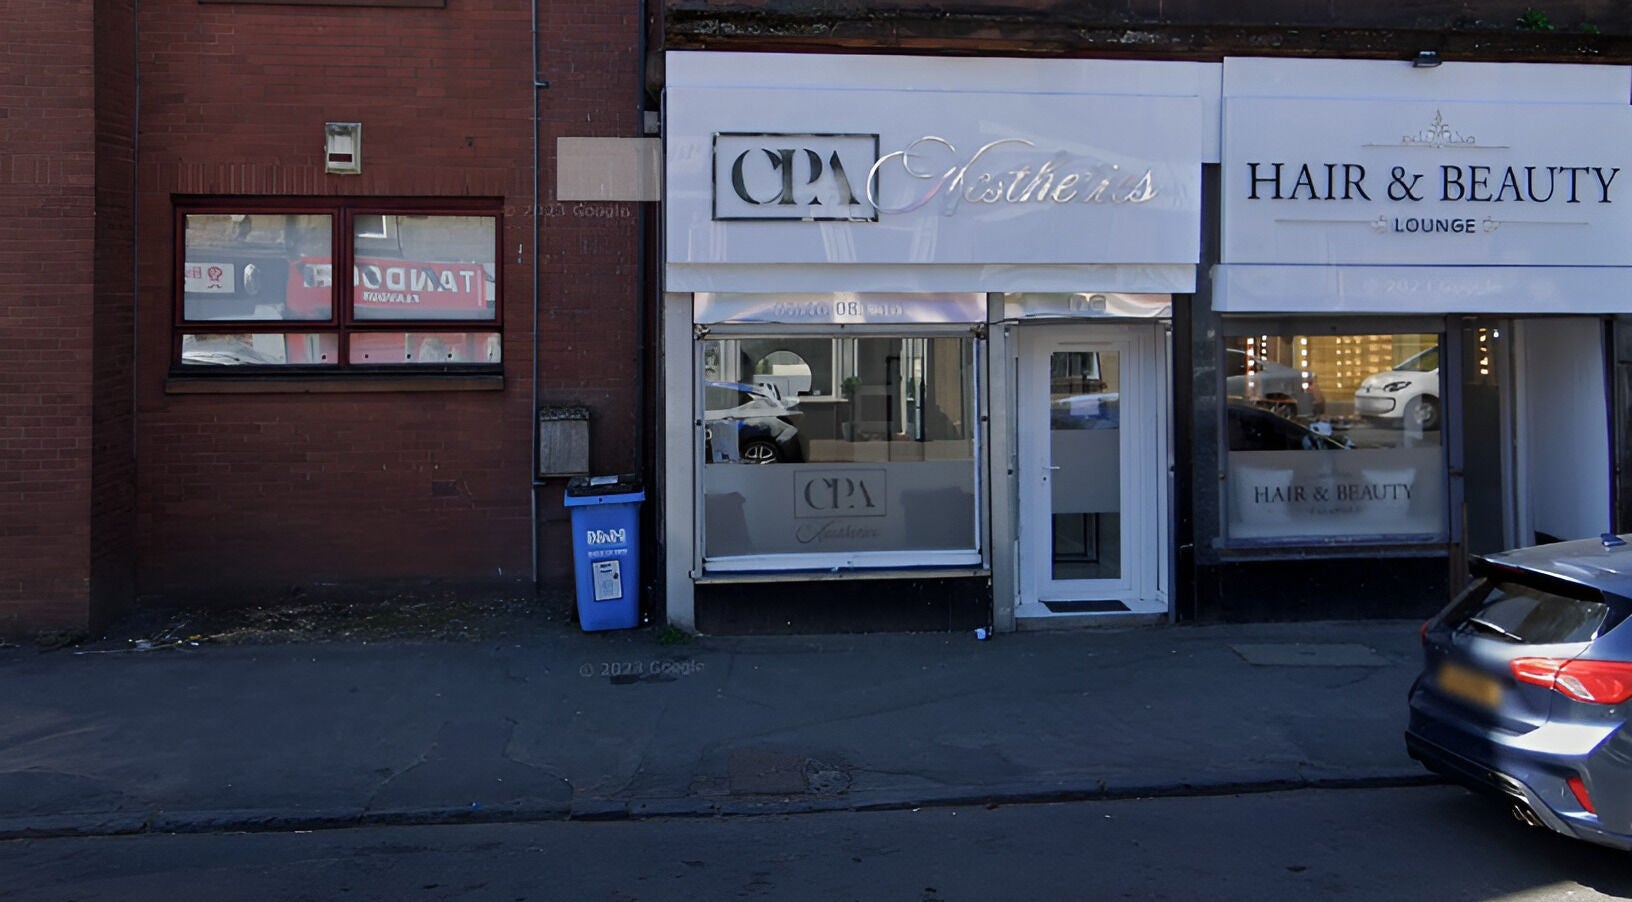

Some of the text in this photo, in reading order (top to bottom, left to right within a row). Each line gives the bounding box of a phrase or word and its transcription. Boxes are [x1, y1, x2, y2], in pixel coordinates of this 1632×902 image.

[731, 146, 862, 206] CPA
[1246, 162, 1621, 204] HAIR & BEAUTY
[1393, 217, 1477, 234] LOUNGE
[803, 476, 877, 511] CPA
[1253, 483, 1415, 504] HAIR & BEAUTY
